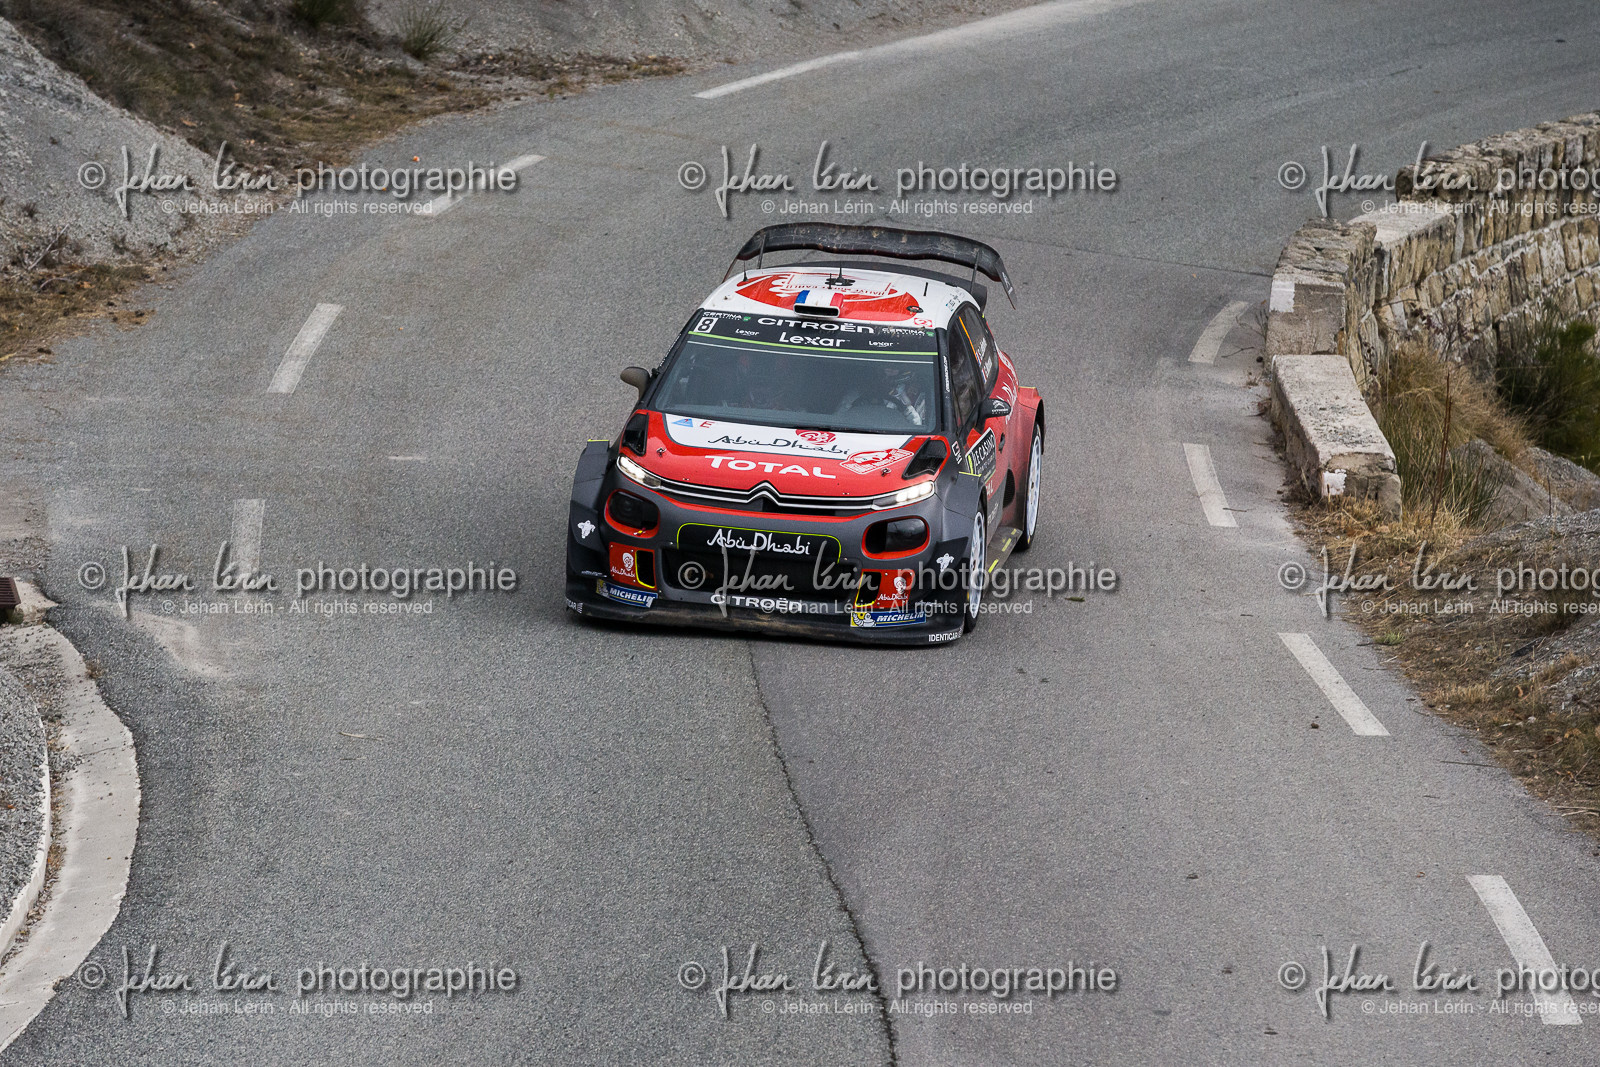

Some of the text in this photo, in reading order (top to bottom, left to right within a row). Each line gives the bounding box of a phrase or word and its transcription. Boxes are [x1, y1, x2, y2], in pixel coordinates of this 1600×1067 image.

[698, 317, 712, 331] 8
[757, 317, 875, 334] CITROËN
[779, 332, 846, 347] Lexar
[705, 455, 837, 479] TOTAL
[707, 529, 811, 555] Abu Dhabi
[609, 587, 656, 604] MICHELIN
[711, 594, 803, 612] CITROËN
[876, 611, 925, 622] MICHELIN
